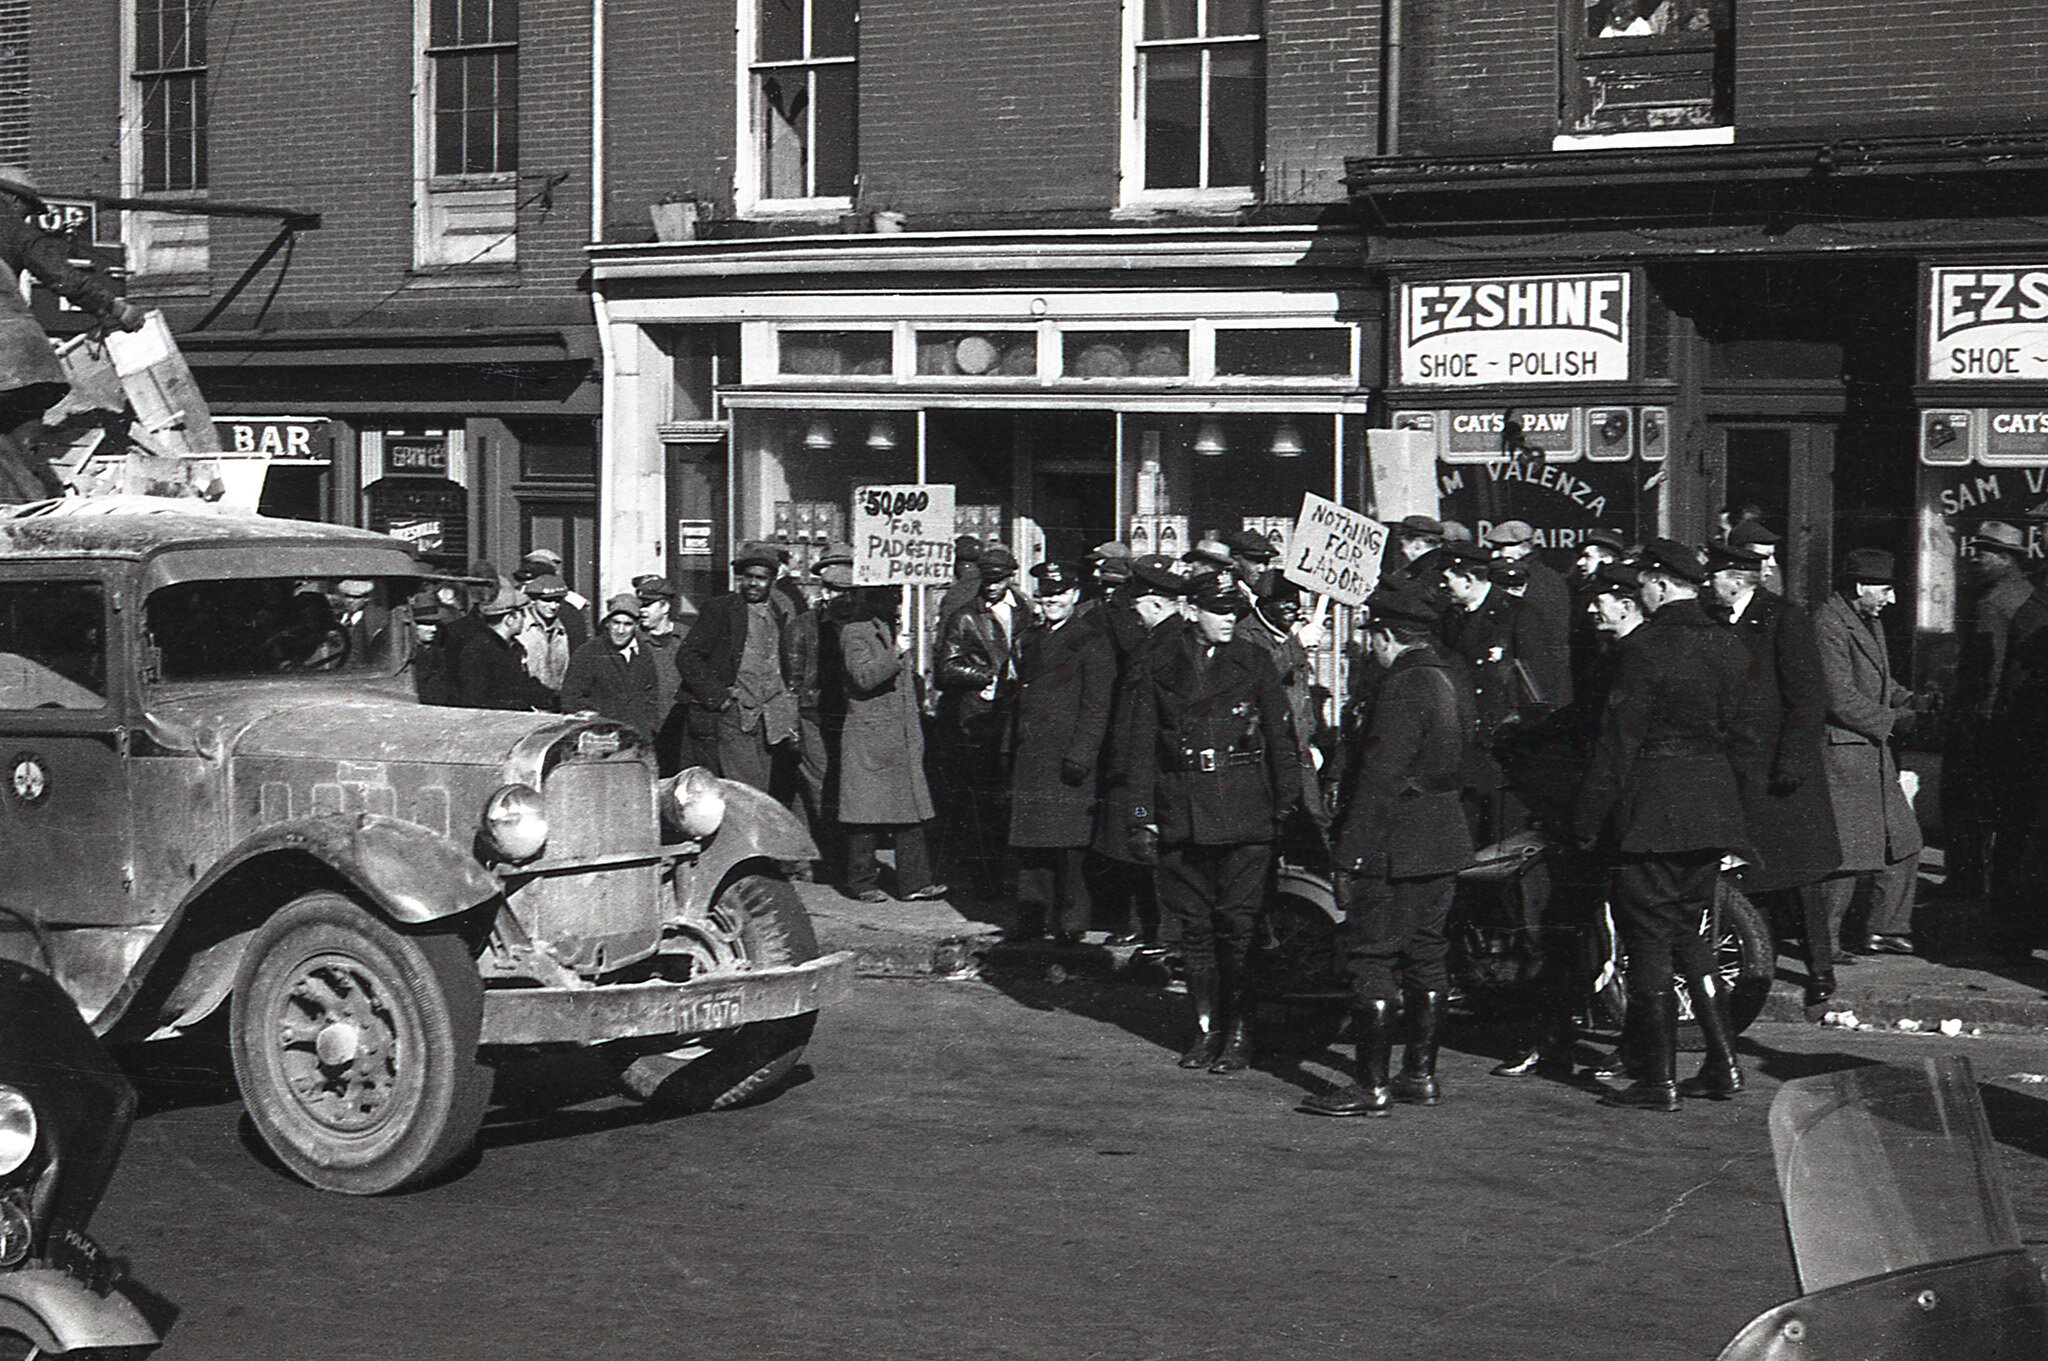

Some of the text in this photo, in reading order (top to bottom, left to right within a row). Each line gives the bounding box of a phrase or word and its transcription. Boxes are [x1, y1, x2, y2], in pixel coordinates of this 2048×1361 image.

[1419, 353, 1478, 378] SHOE
[1508, 350, 1598, 376] POLISH
[1951, 347, 2021, 374] SHOE
[1453, 412, 1505, 433] CAT'S
[1521, 413, 1570, 432] PAW
[232, 425, 311, 457] BAR
[1486, 461, 1607, 518] VALENZA
[1940, 474, 2001, 515] SAM
[1324, 533, 1363, 569] FOR
[887, 559, 952, 579] POCKET
